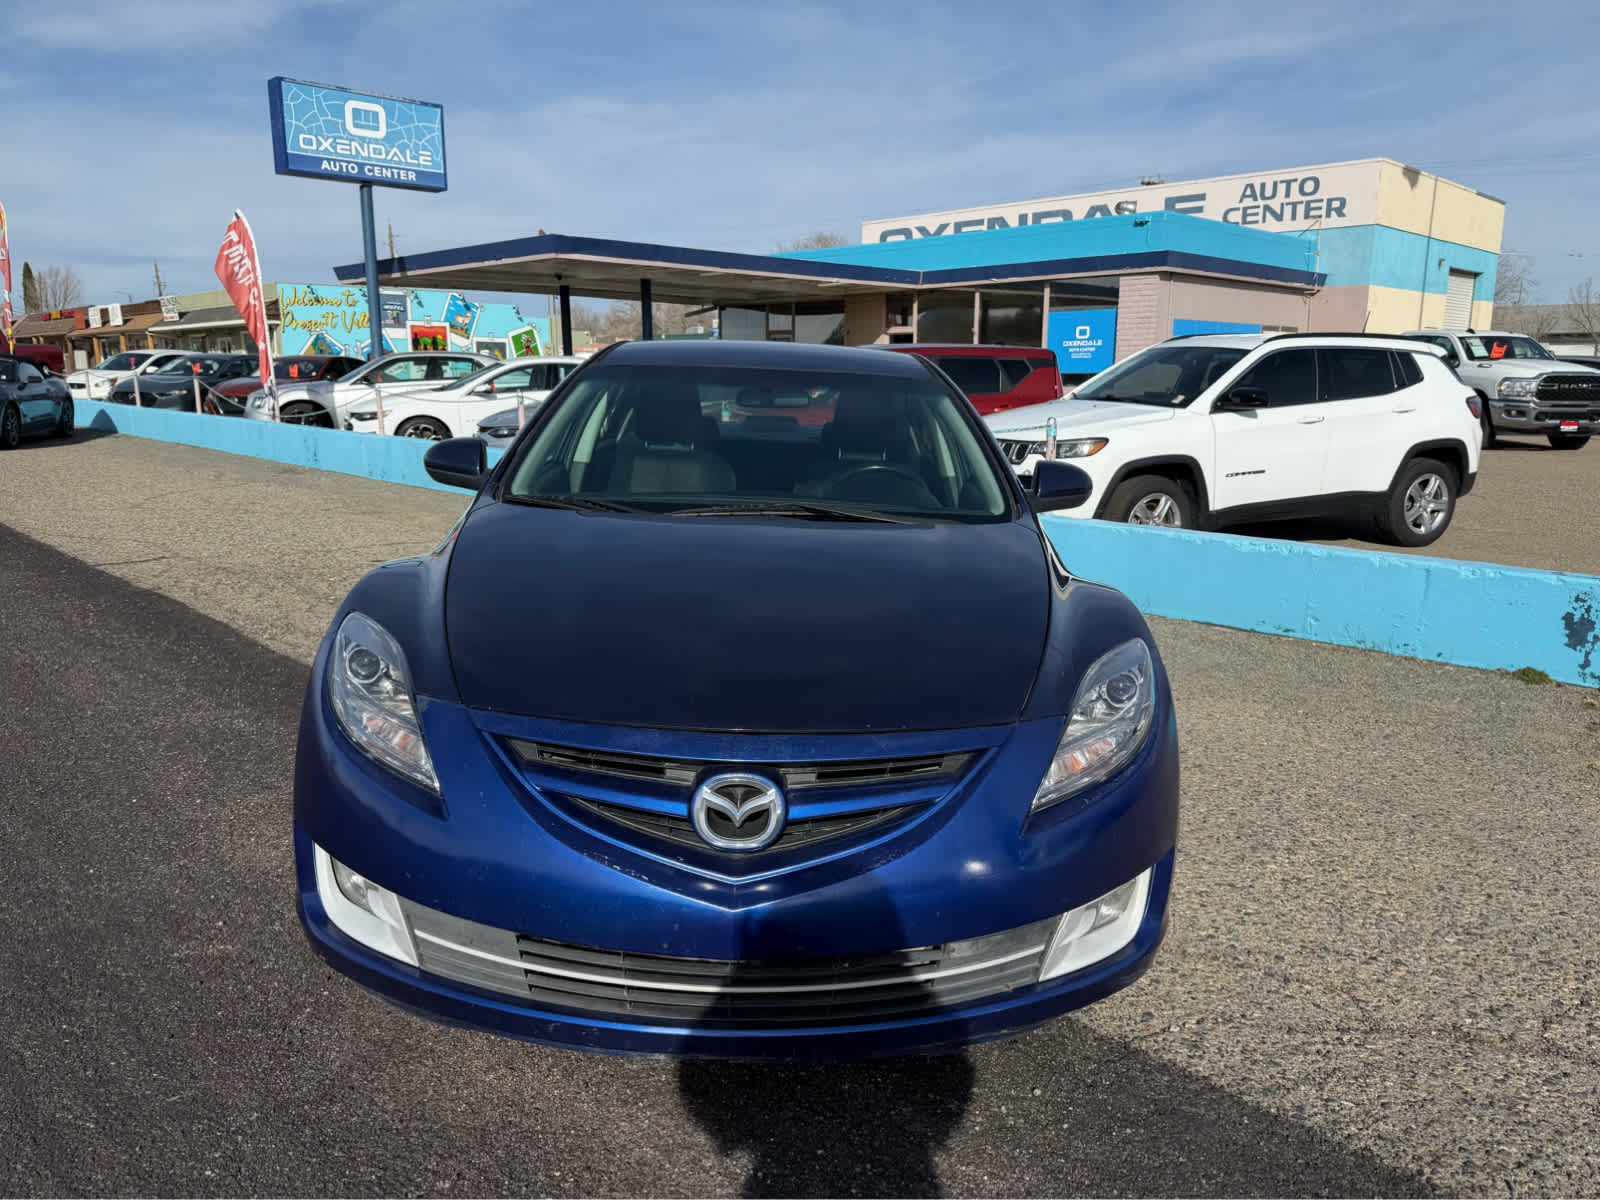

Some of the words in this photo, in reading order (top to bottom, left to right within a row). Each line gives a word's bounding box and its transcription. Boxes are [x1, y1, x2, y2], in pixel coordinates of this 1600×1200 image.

[299, 133, 433, 166] OXENDALE
[321, 160, 359, 175] AUTO
[364, 165, 417, 181] CENTER
[1239, 175, 1321, 204] AUTO
[879, 193, 1207, 243] OXENDAE
[1222, 197, 1347, 226] CENTER
[280, 287, 342, 310] Welcome
[342, 290, 360, 307] to
[342, 310, 371, 334] Vall
